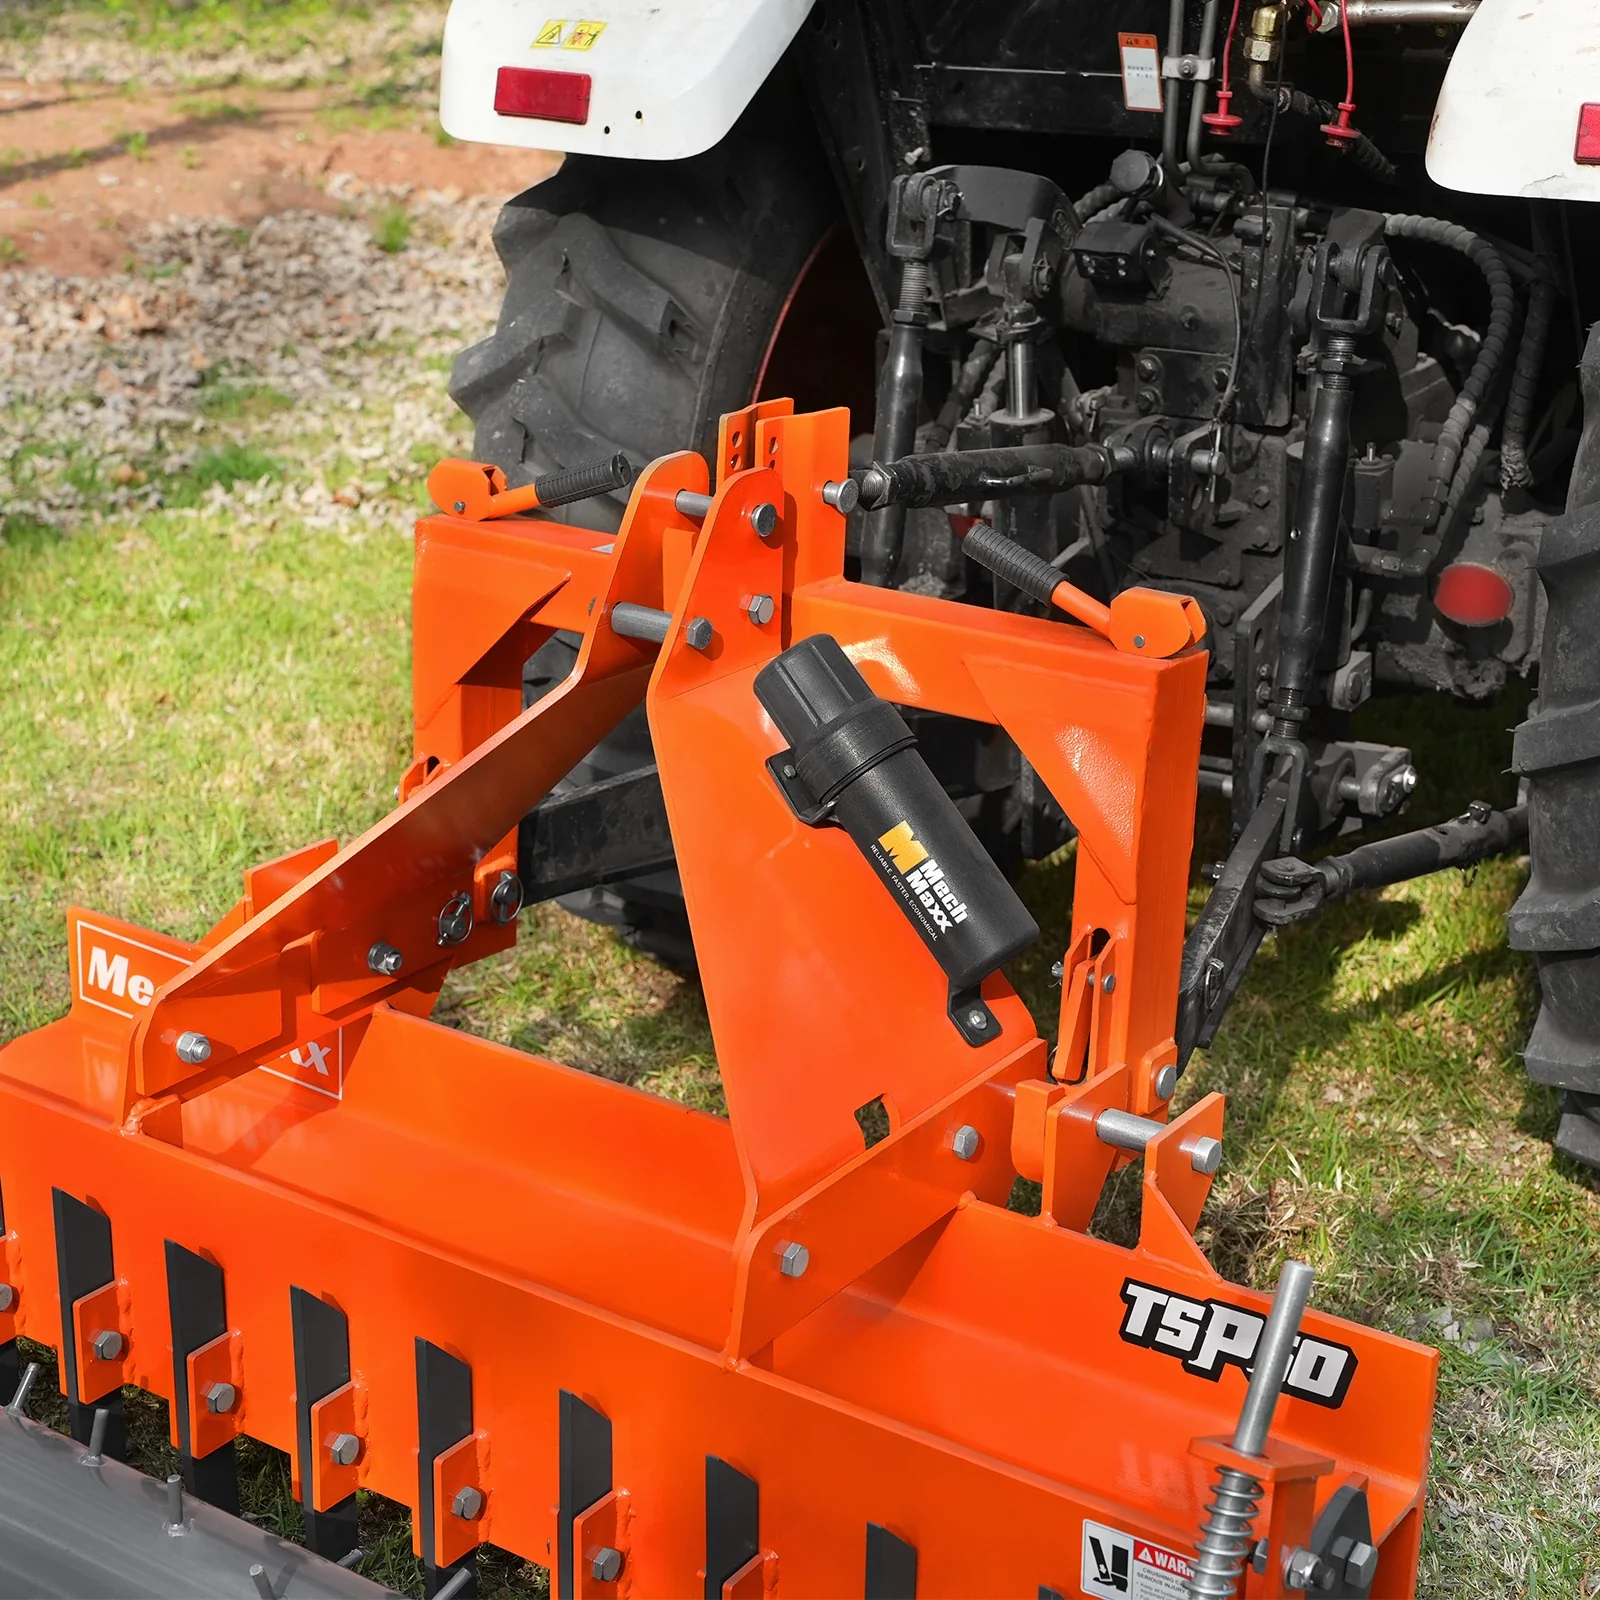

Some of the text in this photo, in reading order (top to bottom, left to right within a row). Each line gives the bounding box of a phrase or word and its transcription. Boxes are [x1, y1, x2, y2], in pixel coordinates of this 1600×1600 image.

[905, 869, 954, 934] Maxx
[908, 898, 938, 941] ECONOMICAL
[919, 859, 968, 924] Mech
[88, 945, 162, 1007] Me
[1125, 1283, 1350, 1399] TSP0
[1136, 1571, 1164, 1586] SERIOUS
[1142, 1567, 1174, 1583] CRUSHING
